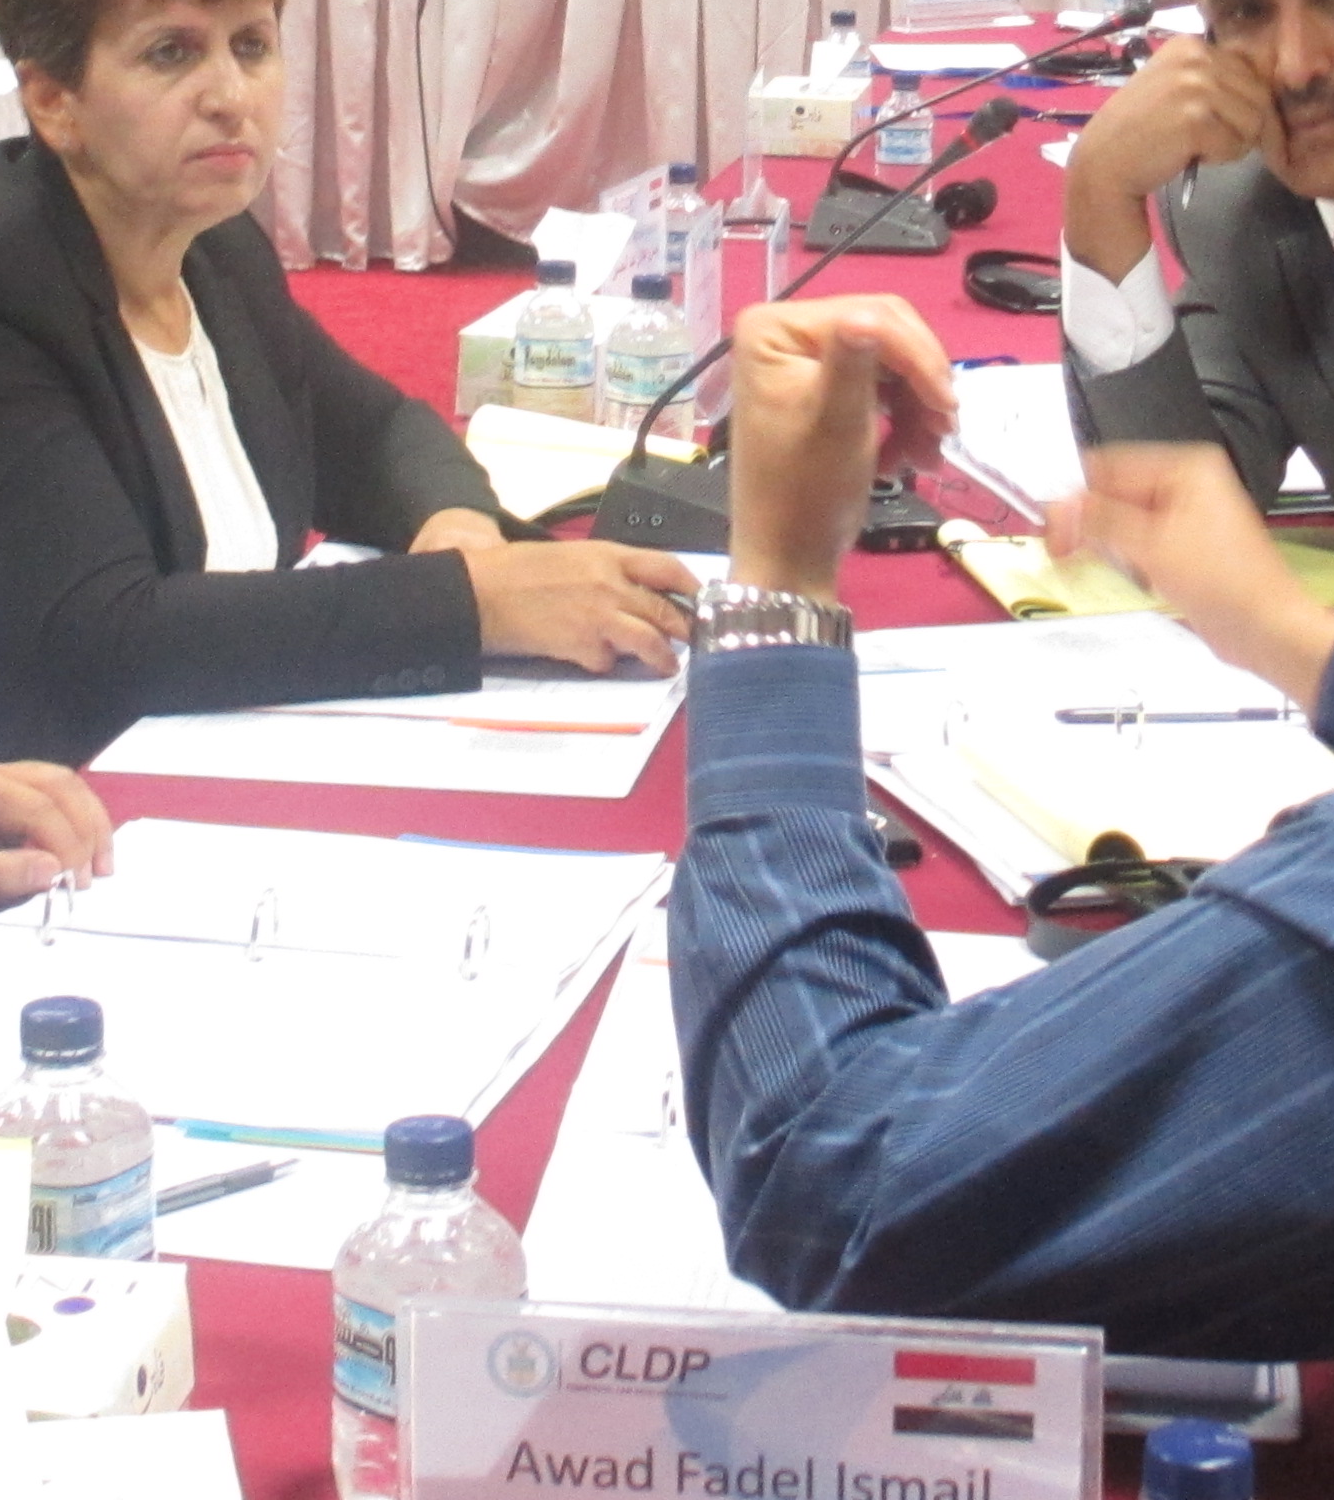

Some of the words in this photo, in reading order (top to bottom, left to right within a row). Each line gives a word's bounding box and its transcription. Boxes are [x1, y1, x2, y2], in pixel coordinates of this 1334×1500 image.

[579, 1342, 713, 1385] CLDP
[505, 1439, 654, 1491] Awad
[676, 1452, 814, 1499] Fadel
[836, 1461, 993, 1500] Ismail
